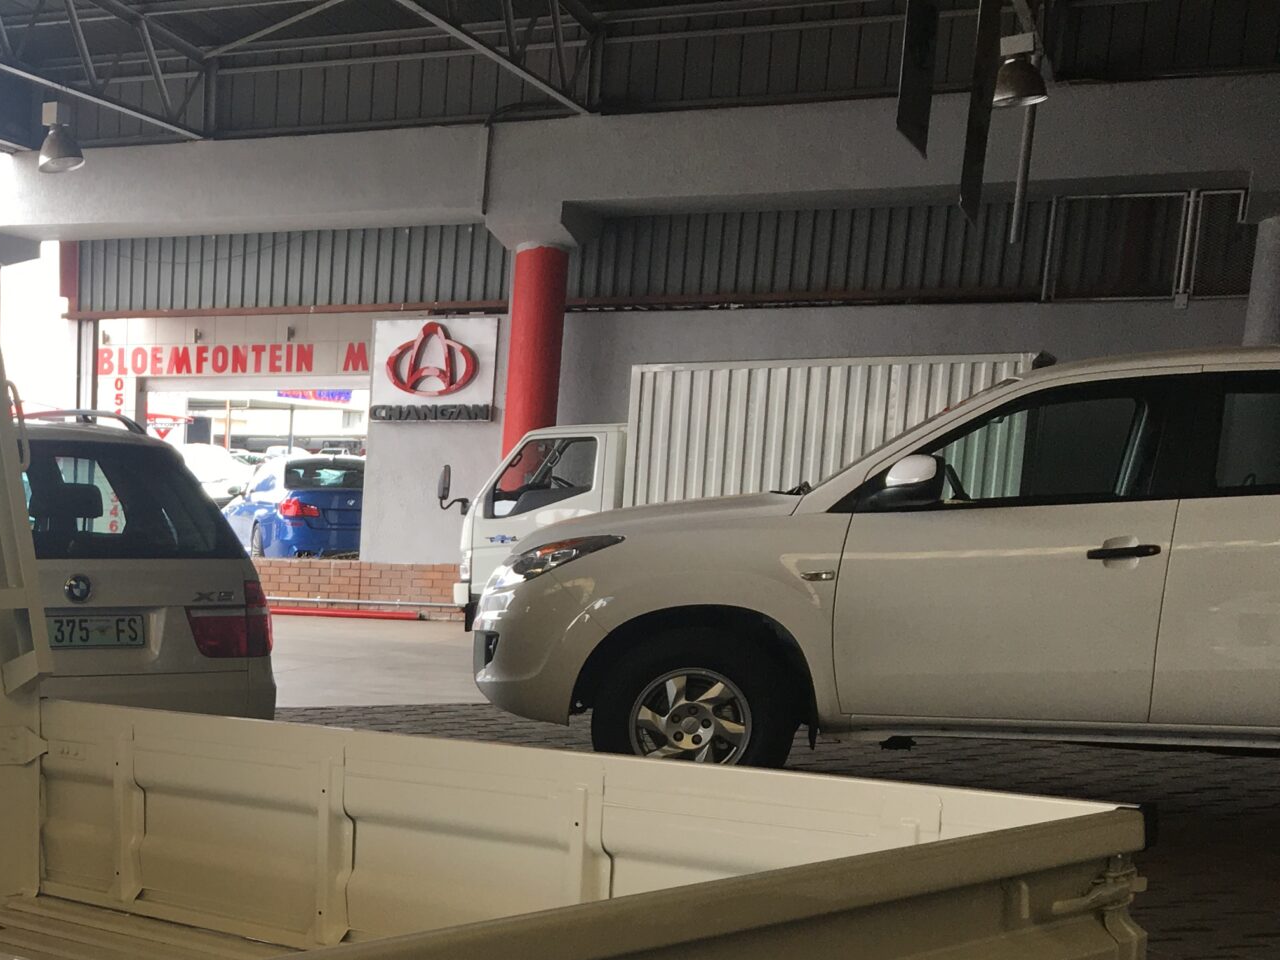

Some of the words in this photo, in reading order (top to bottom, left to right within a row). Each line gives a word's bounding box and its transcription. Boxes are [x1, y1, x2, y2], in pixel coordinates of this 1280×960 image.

[97, 343, 314, 375] BLOEMFONTEIN
[343, 341, 368, 372] M
[370, 403, 490, 421] CHANGAN
[54, 619, 90, 643] 375
[116, 617, 138, 642] FS
